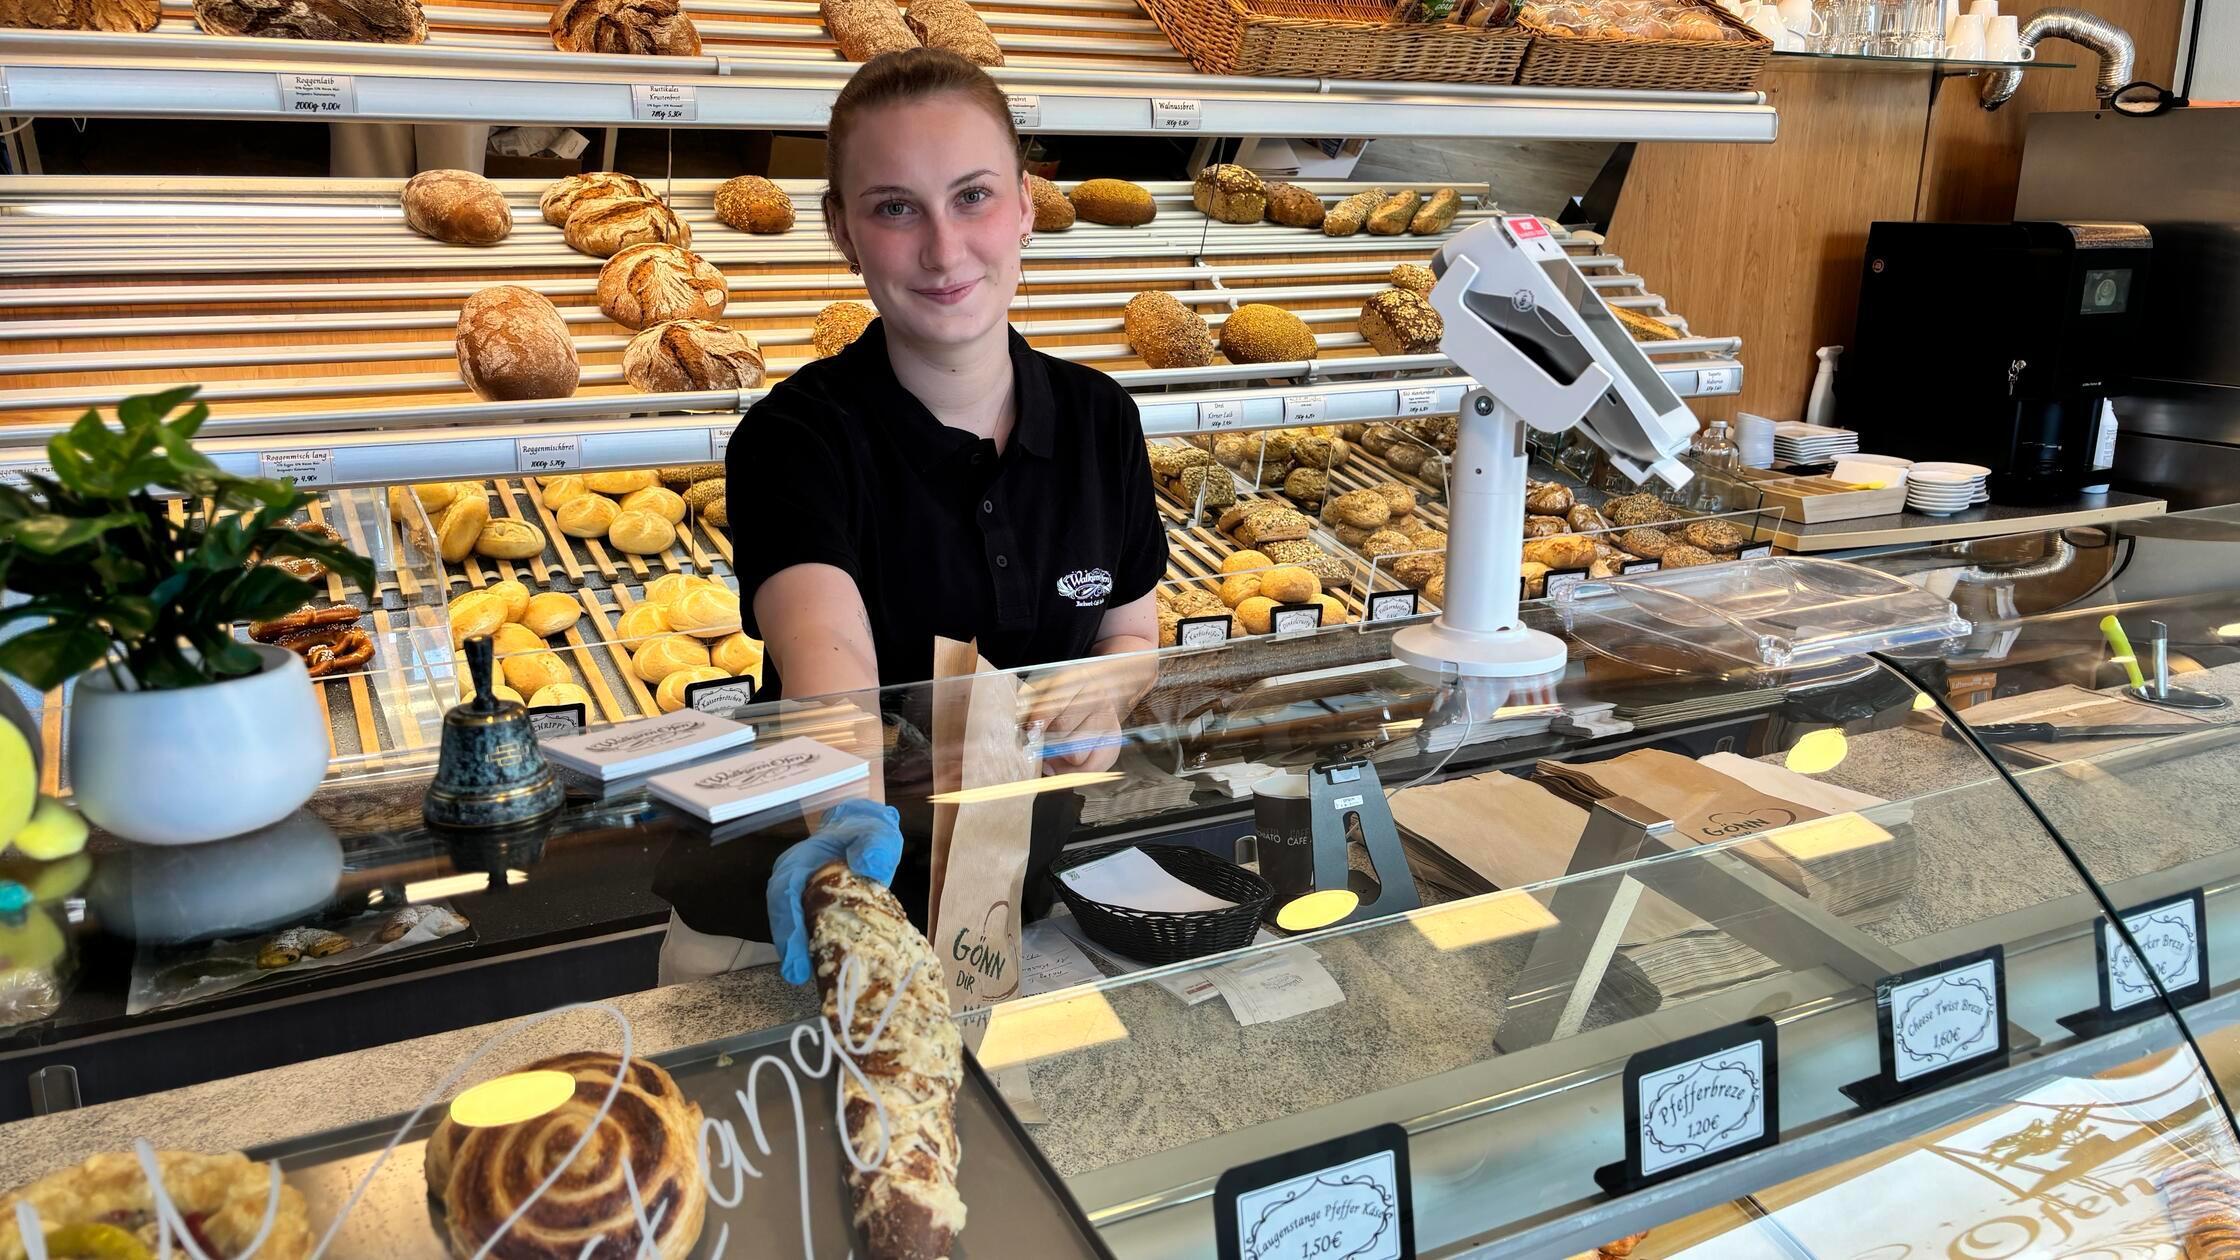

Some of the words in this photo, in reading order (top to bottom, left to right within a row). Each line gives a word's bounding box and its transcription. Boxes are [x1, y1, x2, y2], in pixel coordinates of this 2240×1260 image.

[296, 76, 335, 87] Roggenlaib
[294, 101, 319, 112] 2000g
[1158, 101, 1195, 111] Walnussbrot
[266, 452, 310, 465] Roggenmisch
[312, 451, 327, 461] lang
[522, 442, 575, 456] Roggenmischbrot
[702, 694, 742, 707] Kaiserbrötchen
[1702, 818, 1771, 837] GÖNN
[2162, 934, 2185, 951] Breze
[953, 927, 1006, 981] GÖNN
[956, 970, 976, 995] DIR
[1907, 1011, 1935, 1038] Cheese
[1936, 999, 1960, 1016] Twist
[1961, 998, 1985, 1016] Breze
[1658, 1075, 1746, 1127] Pfefferbreze
[1687, 1114, 1720, 1139] 1,20€
[1254, 1209, 1322, 1258] Laugenstange
[1324, 1199, 1361, 1222] Pfeffer
[1362, 1201, 1383, 1217] Käse
[1302, 1230, 1344, 1259] 1,50€
